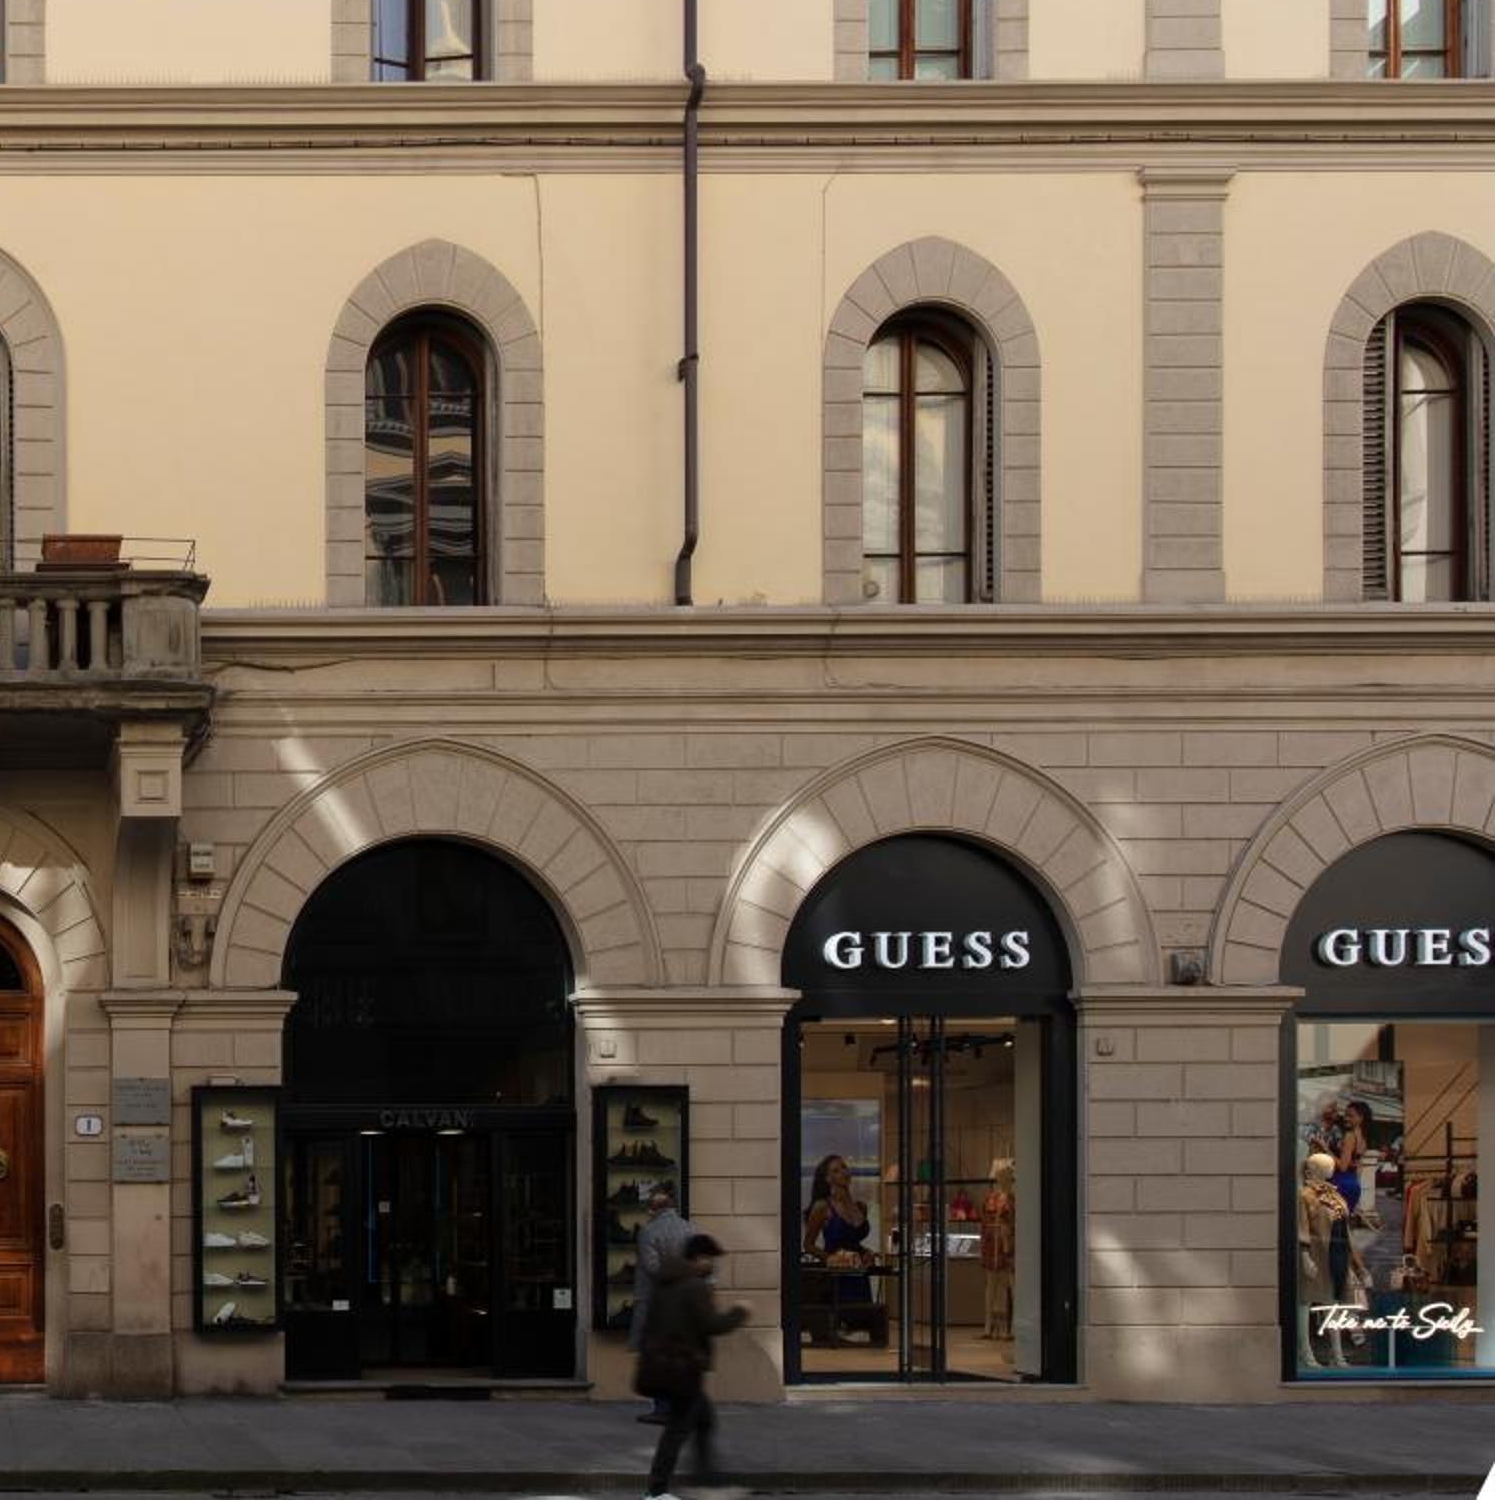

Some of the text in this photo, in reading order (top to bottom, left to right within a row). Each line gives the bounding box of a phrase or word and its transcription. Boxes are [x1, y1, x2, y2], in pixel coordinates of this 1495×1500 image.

[822, 930, 1031, 969] GUESS
[85, 1118, 93, 1133] 1
[1310, 1303, 1368, 1336] Take
[1385, 1307, 1411, 1330] to
[1412, 1302, 1485, 1340] Sicily
